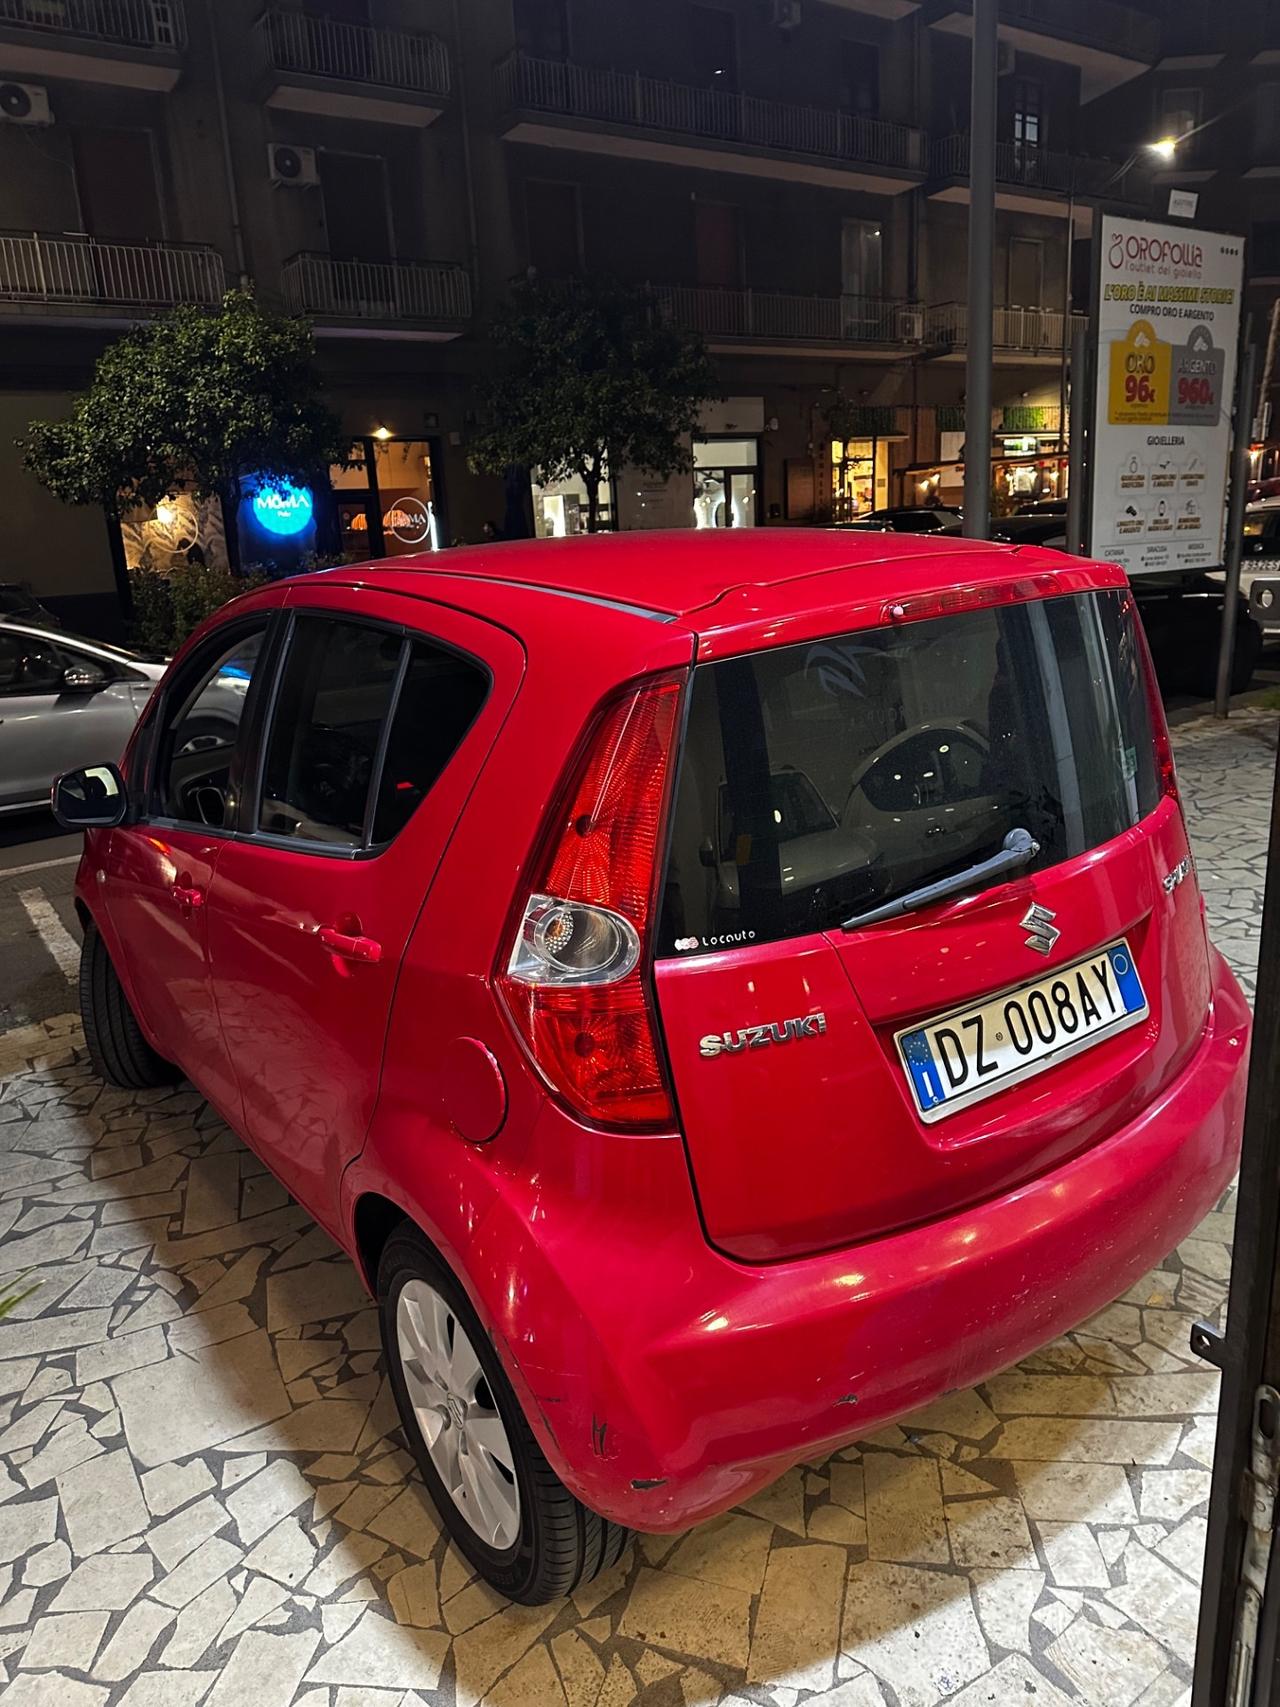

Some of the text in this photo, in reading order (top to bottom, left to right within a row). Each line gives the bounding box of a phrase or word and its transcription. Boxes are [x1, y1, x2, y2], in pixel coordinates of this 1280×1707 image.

[1130, 304, 1161, 316] COMPRO
[1162, 306, 1177, 318] ORO
[1184, 309, 1214, 321] ARGENTO
[1126, 354, 1155, 374] ORO
[1147, 435, 1186, 446] GIOIELLERIA
[699, 1012, 827, 1057] SUZUKI
